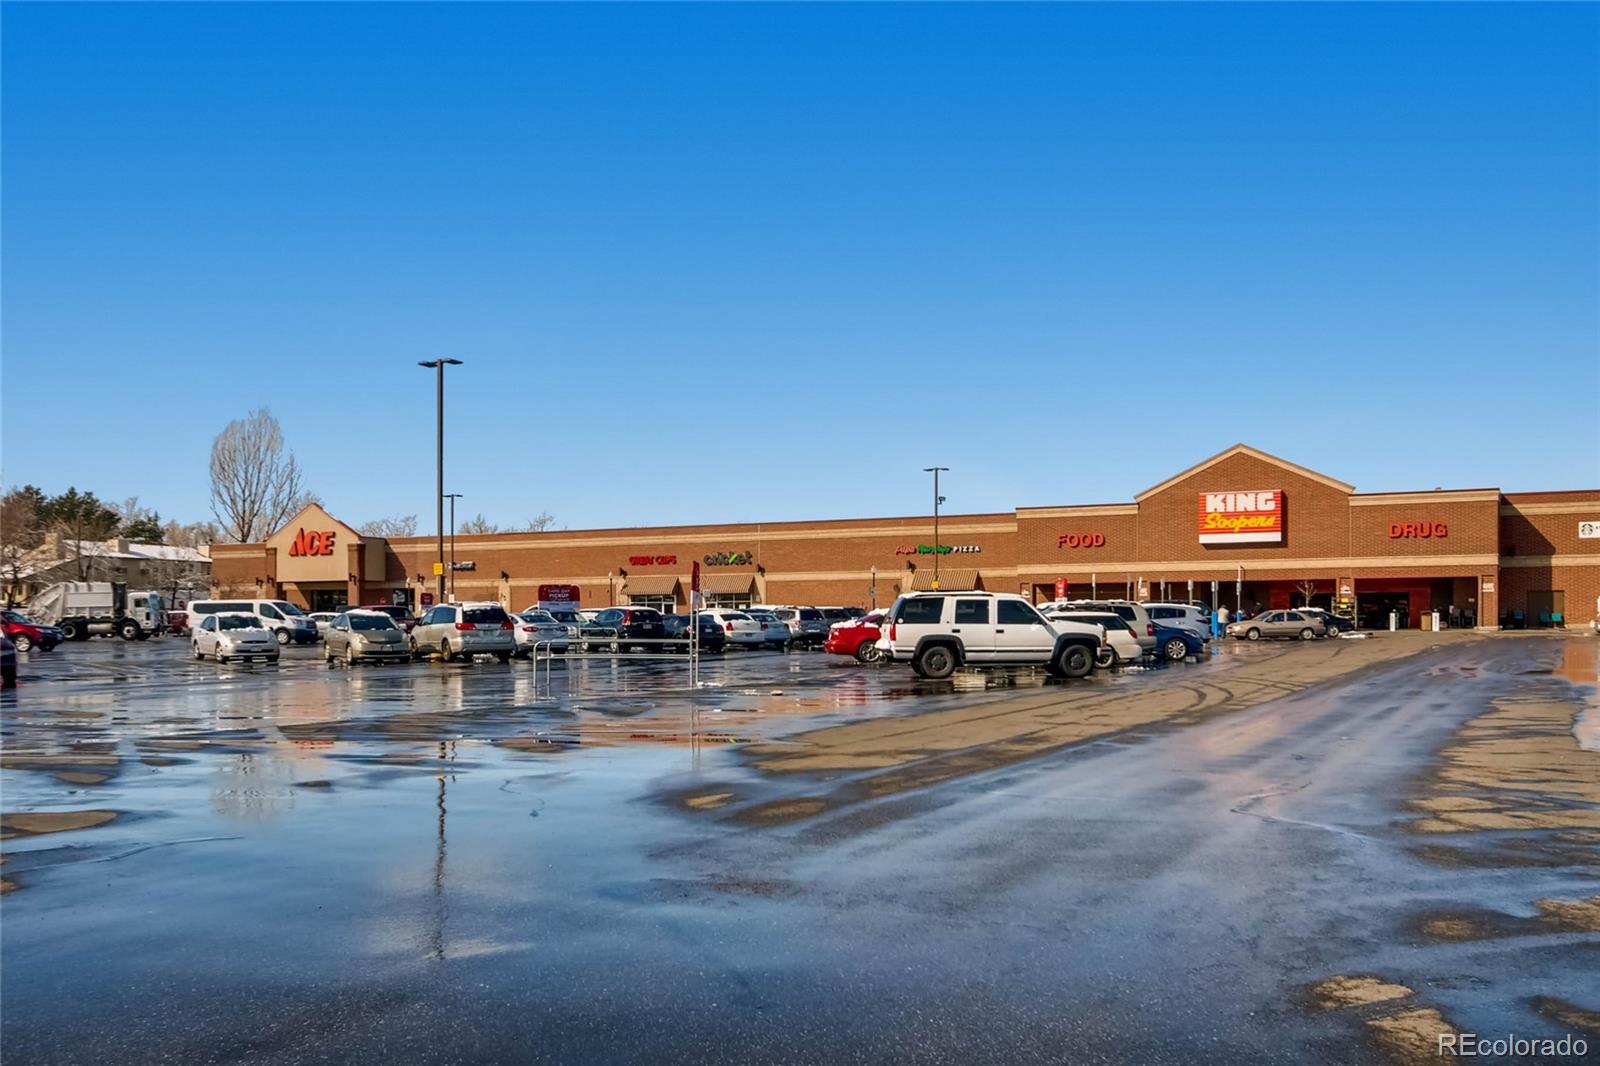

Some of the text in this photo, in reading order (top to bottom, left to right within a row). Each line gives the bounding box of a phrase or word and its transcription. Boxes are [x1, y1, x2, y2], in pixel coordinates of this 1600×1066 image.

[1205, 492, 1276, 513] KING
[1203, 512, 1277, 533] Soopers
[1389, 522, 1448, 539] DRUG
[288, 527, 336, 557] ACE
[1057, 531, 1105, 548] FOOD
[952, 545, 981, 553] PIZZA
[704, 551, 753, 566] cricket
